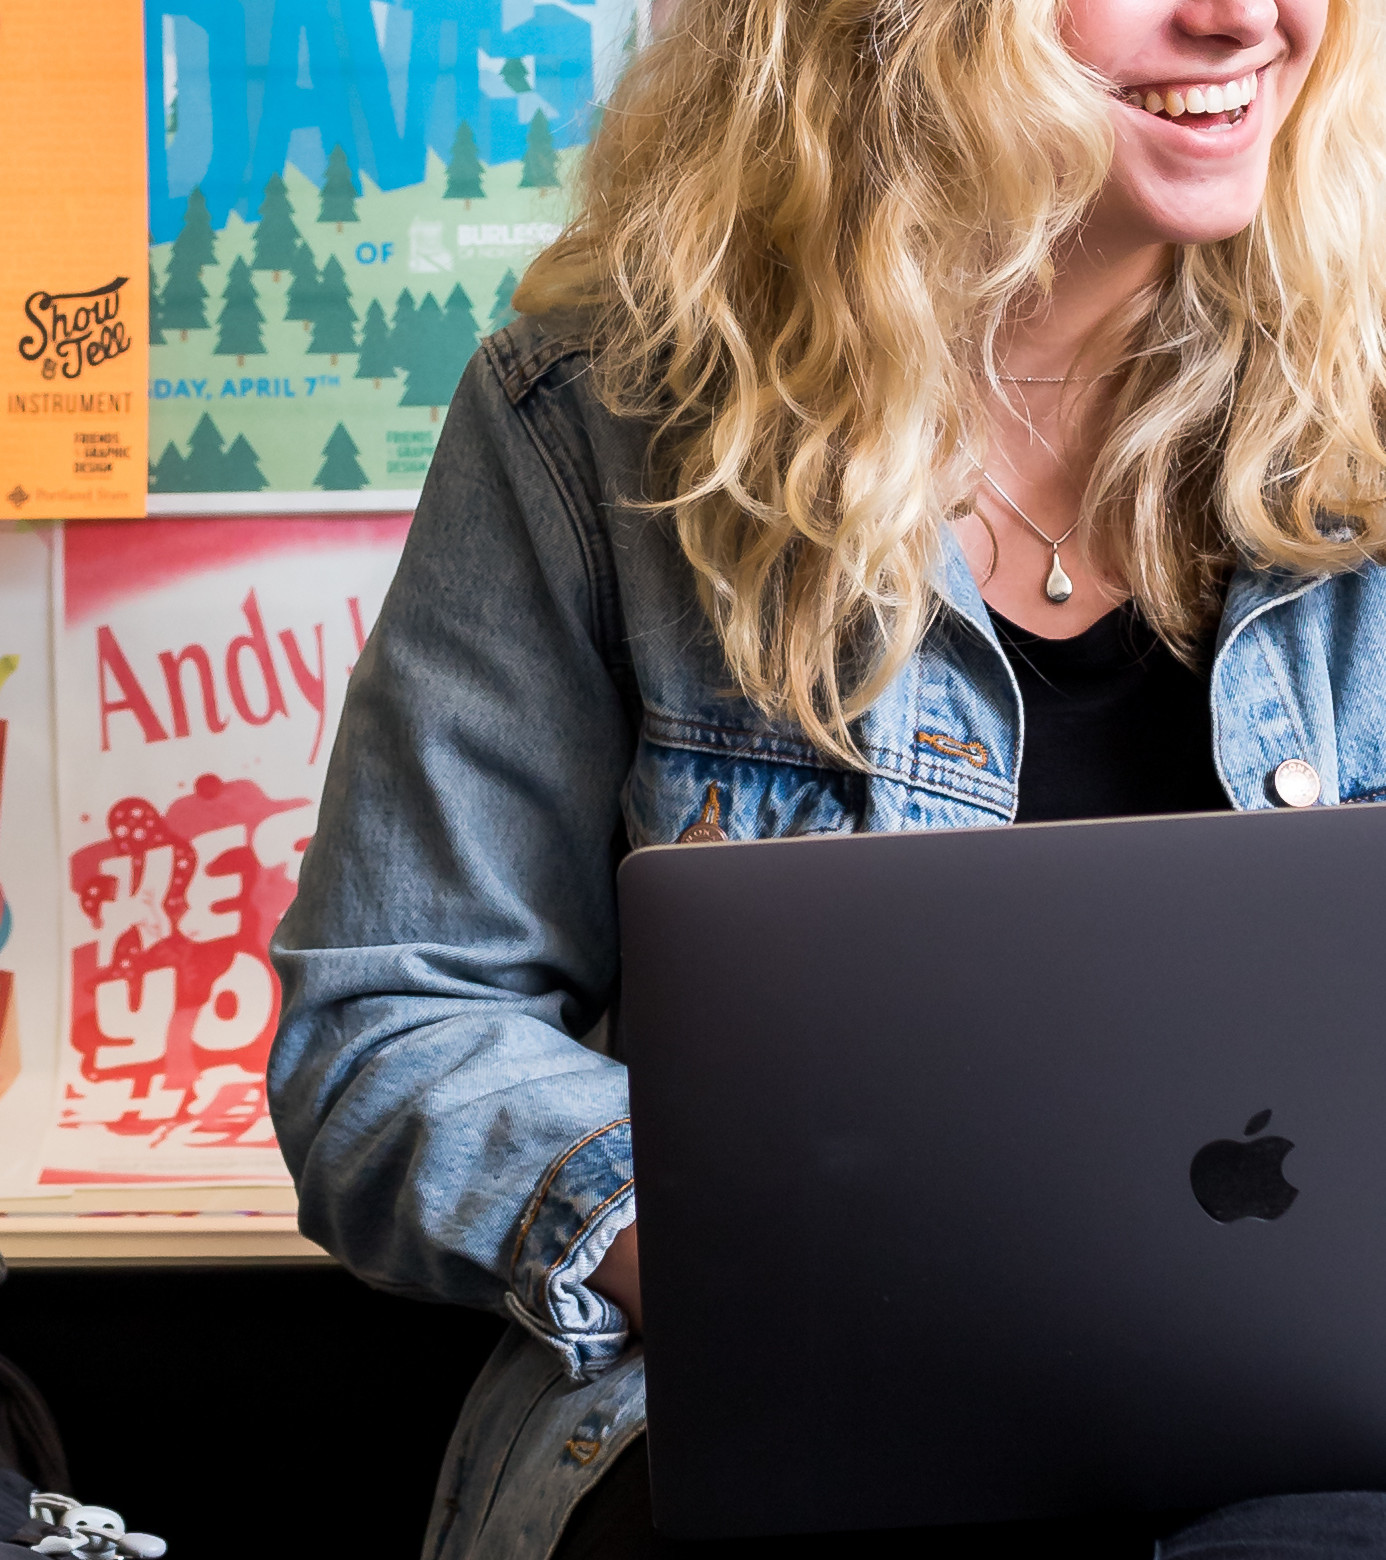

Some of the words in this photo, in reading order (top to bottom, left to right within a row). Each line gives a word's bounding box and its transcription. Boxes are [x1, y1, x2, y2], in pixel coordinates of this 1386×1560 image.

[19, 280, 122, 361] Show
[60, 324, 130, 382] Tell
[7, 391, 132, 416] INSTRUMENT
[94, 588, 327, 763] Andy
